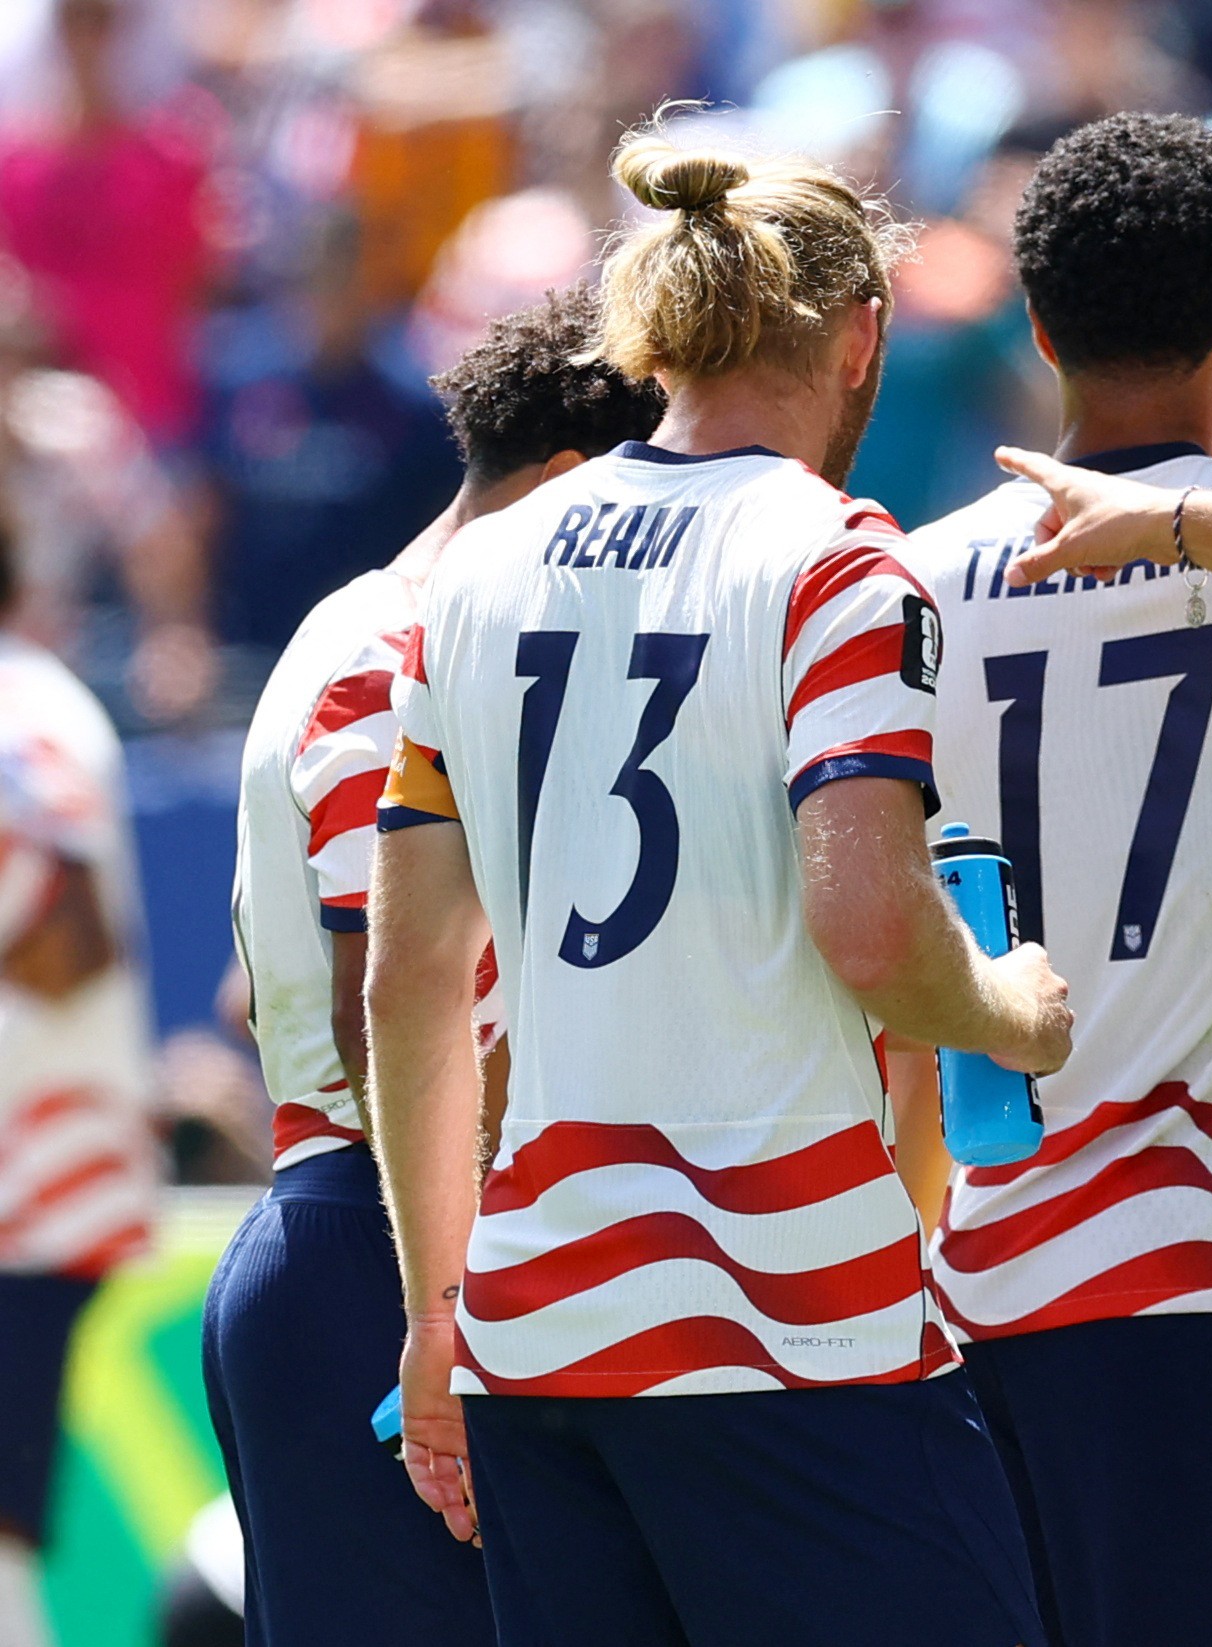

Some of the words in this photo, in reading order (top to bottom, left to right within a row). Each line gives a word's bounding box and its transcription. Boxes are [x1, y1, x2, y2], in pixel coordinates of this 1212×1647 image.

[544, 503, 699, 570] REAM
[515, 631, 710, 968] 13
[782, 1337, 856, 1347] AERO-FIT
